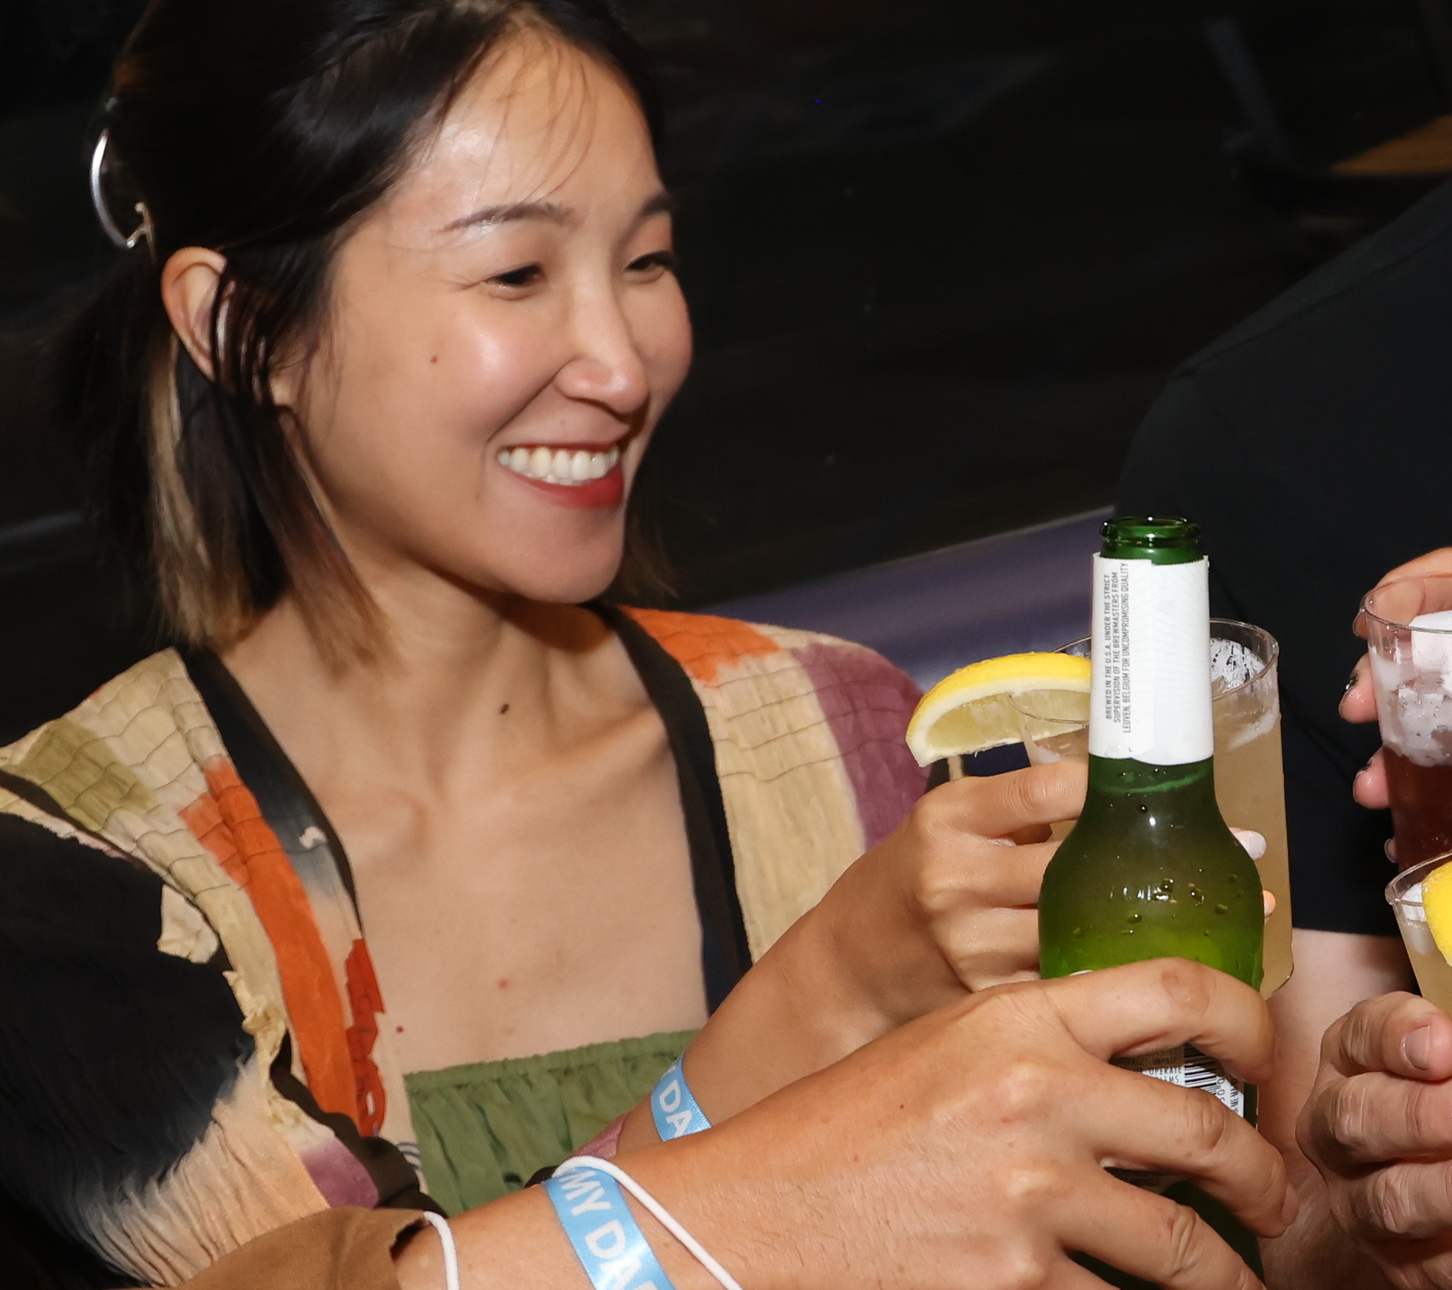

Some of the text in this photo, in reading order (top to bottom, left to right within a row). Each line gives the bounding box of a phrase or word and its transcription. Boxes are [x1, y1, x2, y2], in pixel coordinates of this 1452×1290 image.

[1113, 665, 1120, 674] OF
[1120, 563, 1131, 733] LEUVEN, BELGIUM FOR UNCOMPROMISING QUALITY
[1105, 680, 1111, 688] IN
[1113, 676, 1121, 723] SUPERVISION
[659, 1079, 693, 1139] DA
[559, 1168, 612, 1218] MY
